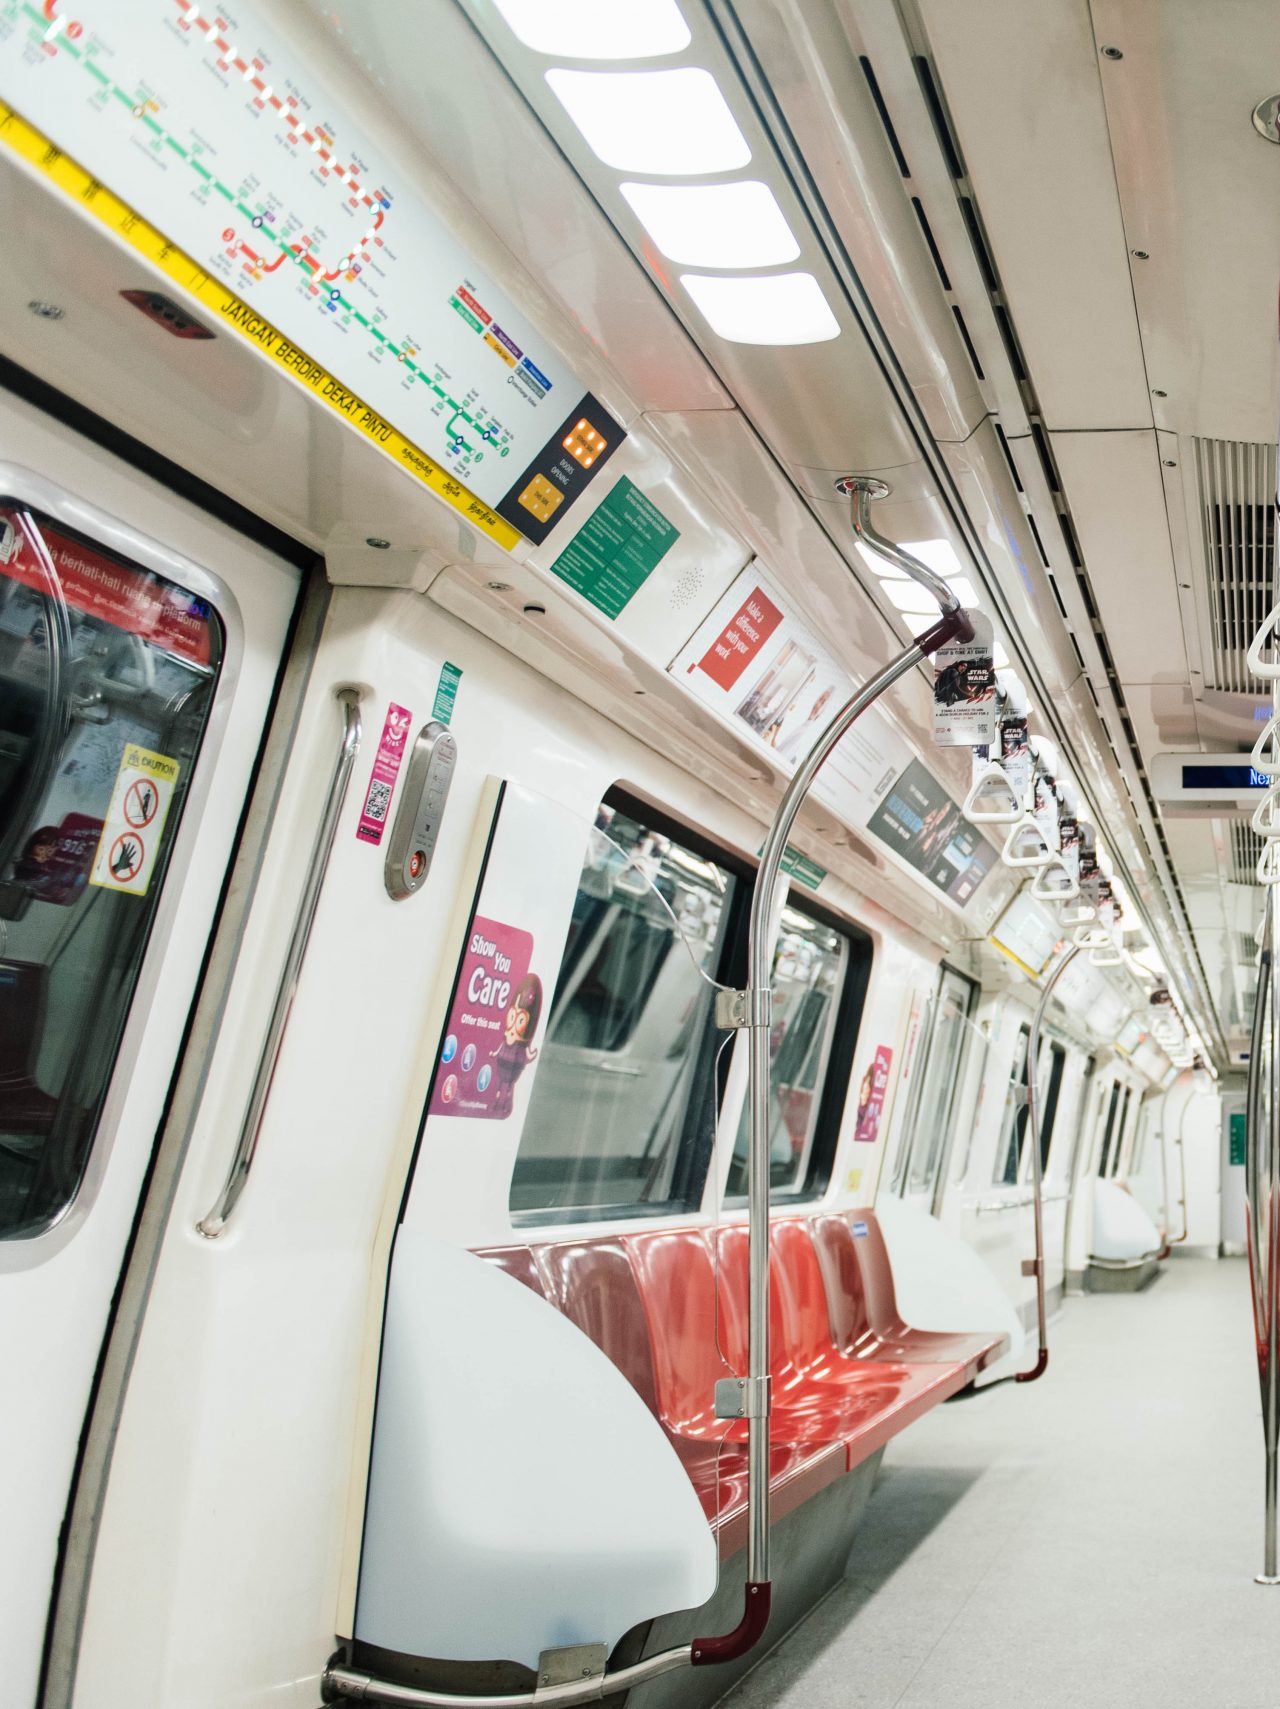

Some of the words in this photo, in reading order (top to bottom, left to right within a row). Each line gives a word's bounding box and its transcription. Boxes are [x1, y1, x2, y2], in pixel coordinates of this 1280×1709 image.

[221, 300, 277, 346] JANGAN
[275, 342, 325, 386] BERDIRI
[322, 382, 363, 416] DEKAT
[360, 412, 392, 442] PINTU
[550, 465, 570, 485] OPENING
[558, 458, 575, 474] DOORS
[57, 550, 123, 591] berhati-hati
[744, 599, 764, 620] Make
[723, 627, 742, 645] with
[733, 612, 764, 642] difference
[713, 640, 733, 660] work
[732, 639, 749, 656] your
[141, 757, 176, 776] CAUTION
[1250, 768, 1274, 785] Nex
[470, 934, 497, 957] Show
[494, 952, 512, 974] You
[468, 965, 511, 1009] Care
[461, 1013, 476, 1026] Offer
[476, 1016, 488, 1028] this
[489, 1021, 501, 1031] seat
